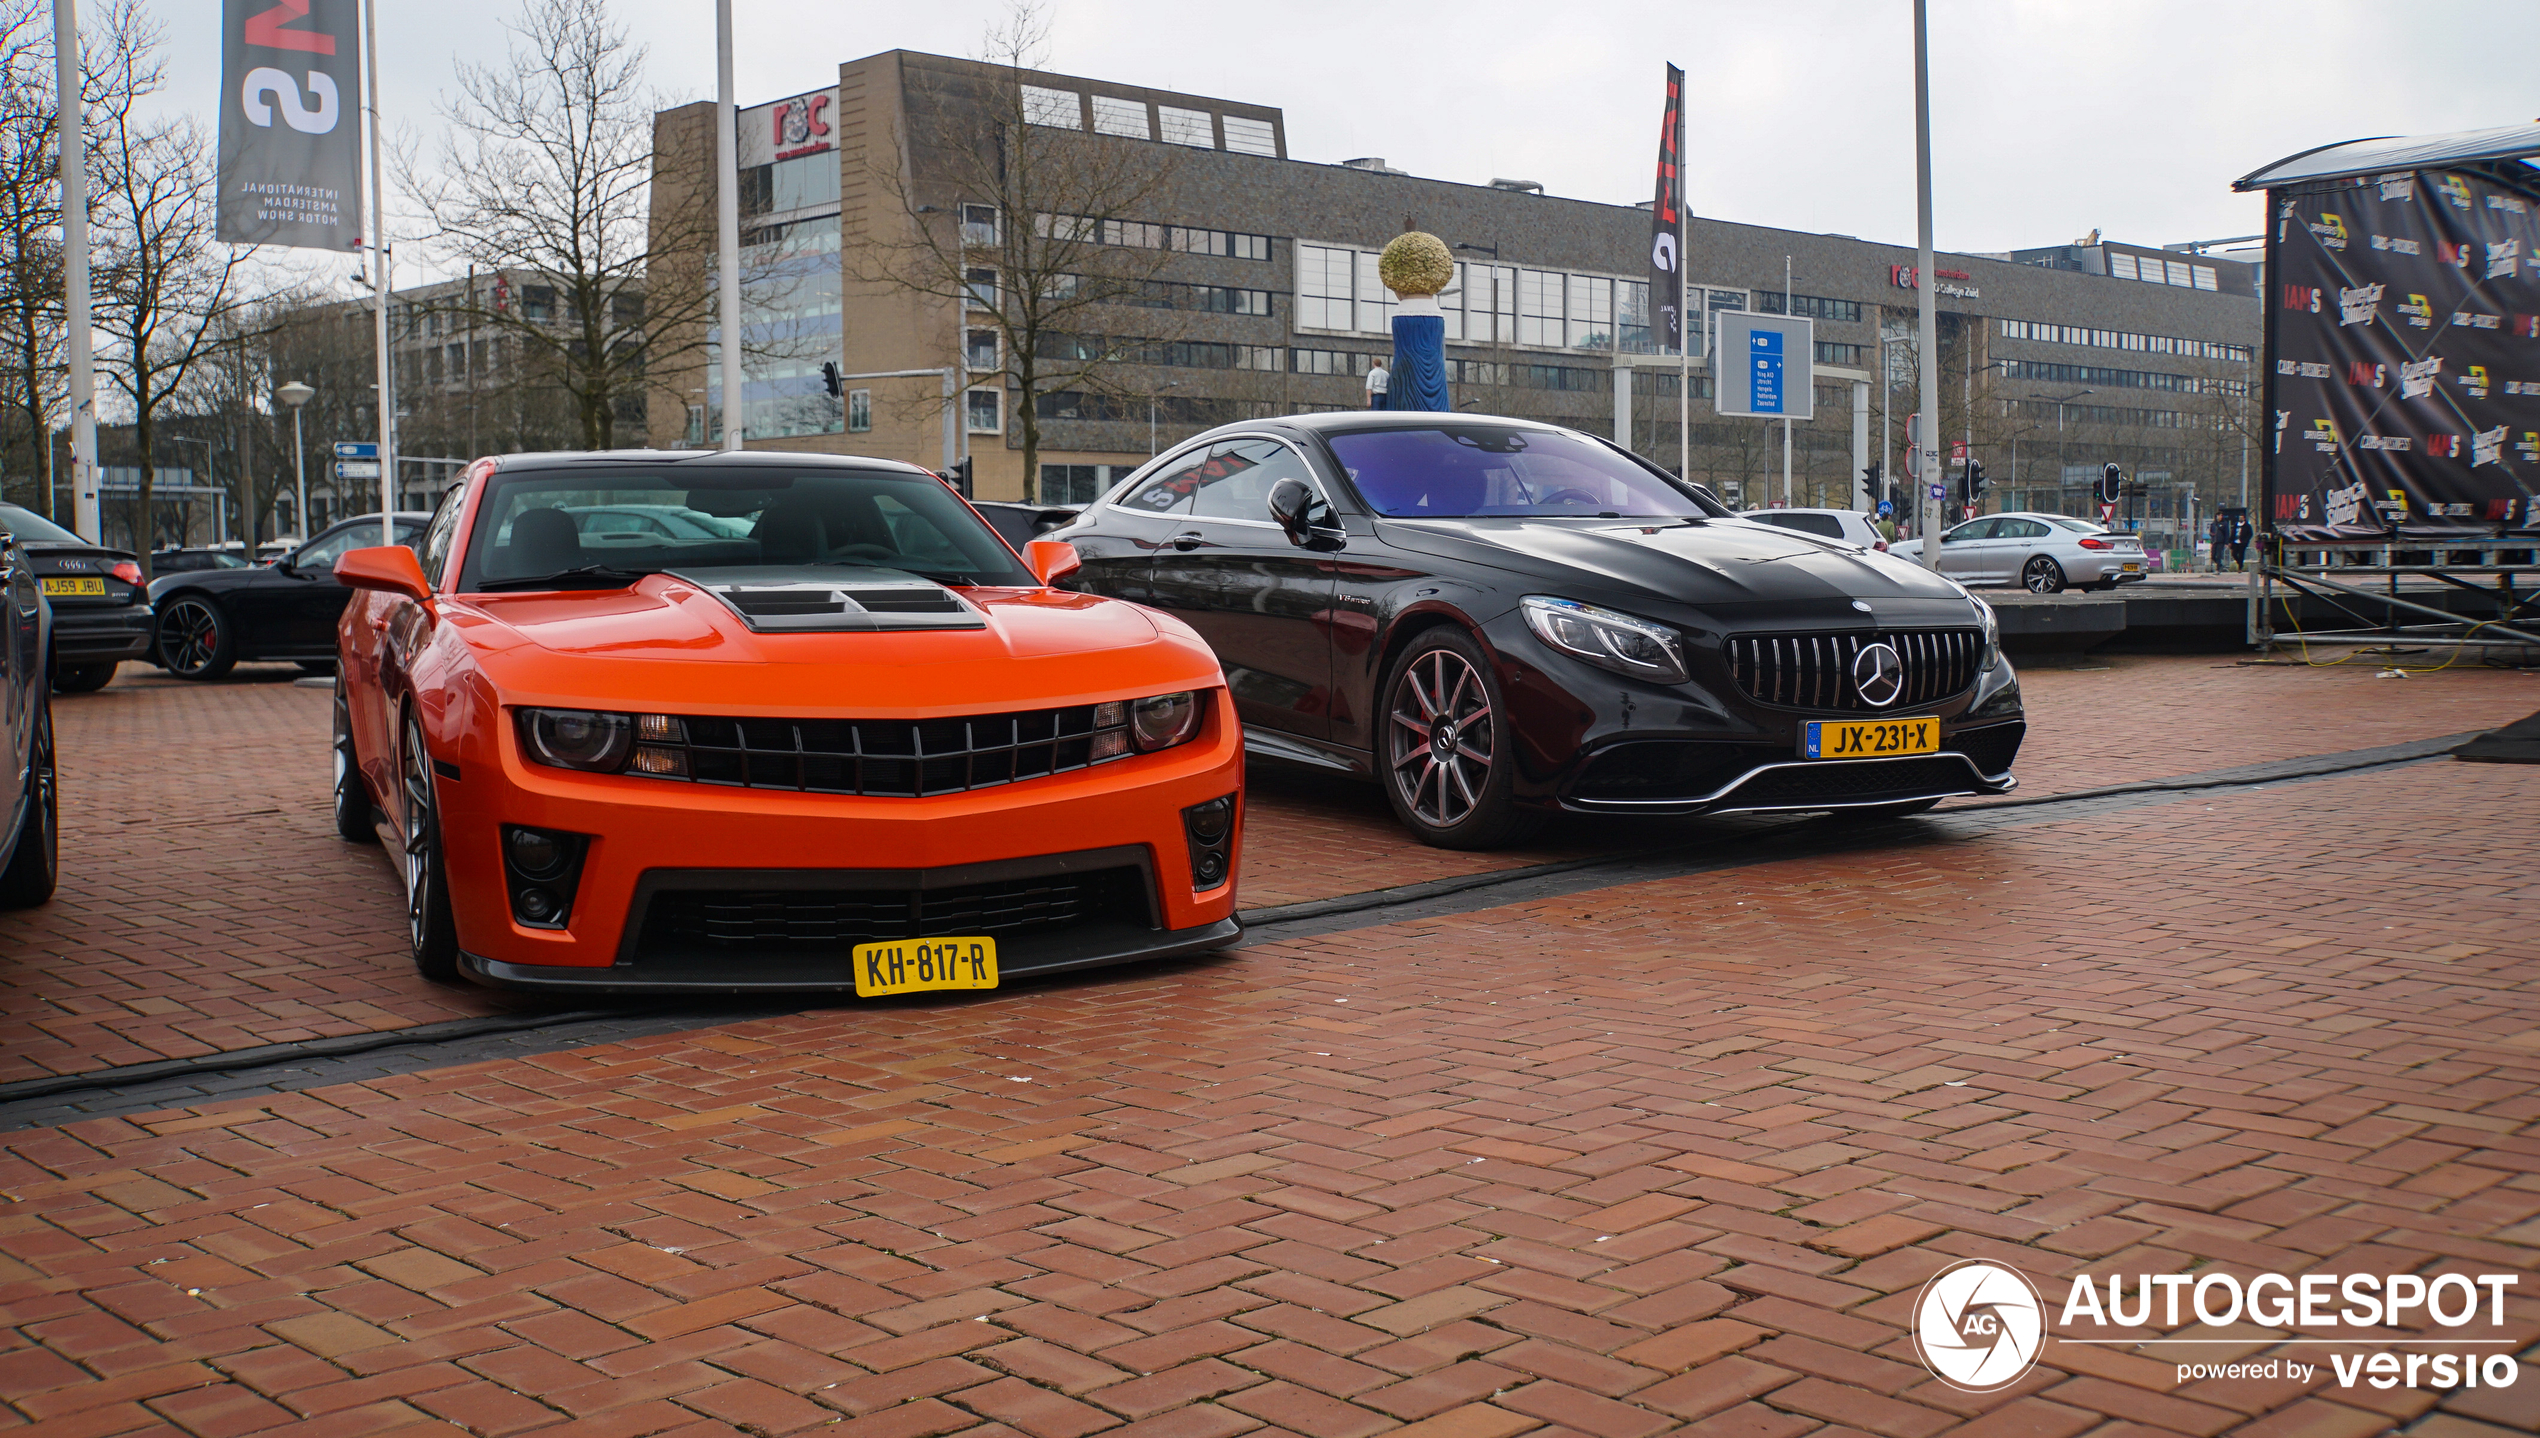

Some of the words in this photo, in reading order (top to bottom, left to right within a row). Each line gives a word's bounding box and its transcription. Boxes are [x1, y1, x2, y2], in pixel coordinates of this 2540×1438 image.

[1940, 283, 1964, 298] College
[1964, 286, 1979, 298] Zuid
[2284, 283, 2321, 314] IAMS
[2277, 359, 2297, 376] CARS
[2300, 362, 2331, 379] BUSINESS
[2348, 361, 2386, 388] IAMS
[2275, 494, 2310, 519] IAMS
[45, 580, 76, 593] AJ59
[80, 580, 102, 592] JBU
[1808, 744, 1819, 753] NL
[1834, 723, 1927, 753] JX-231-X
[866, 944, 987, 986] KH-817-R
